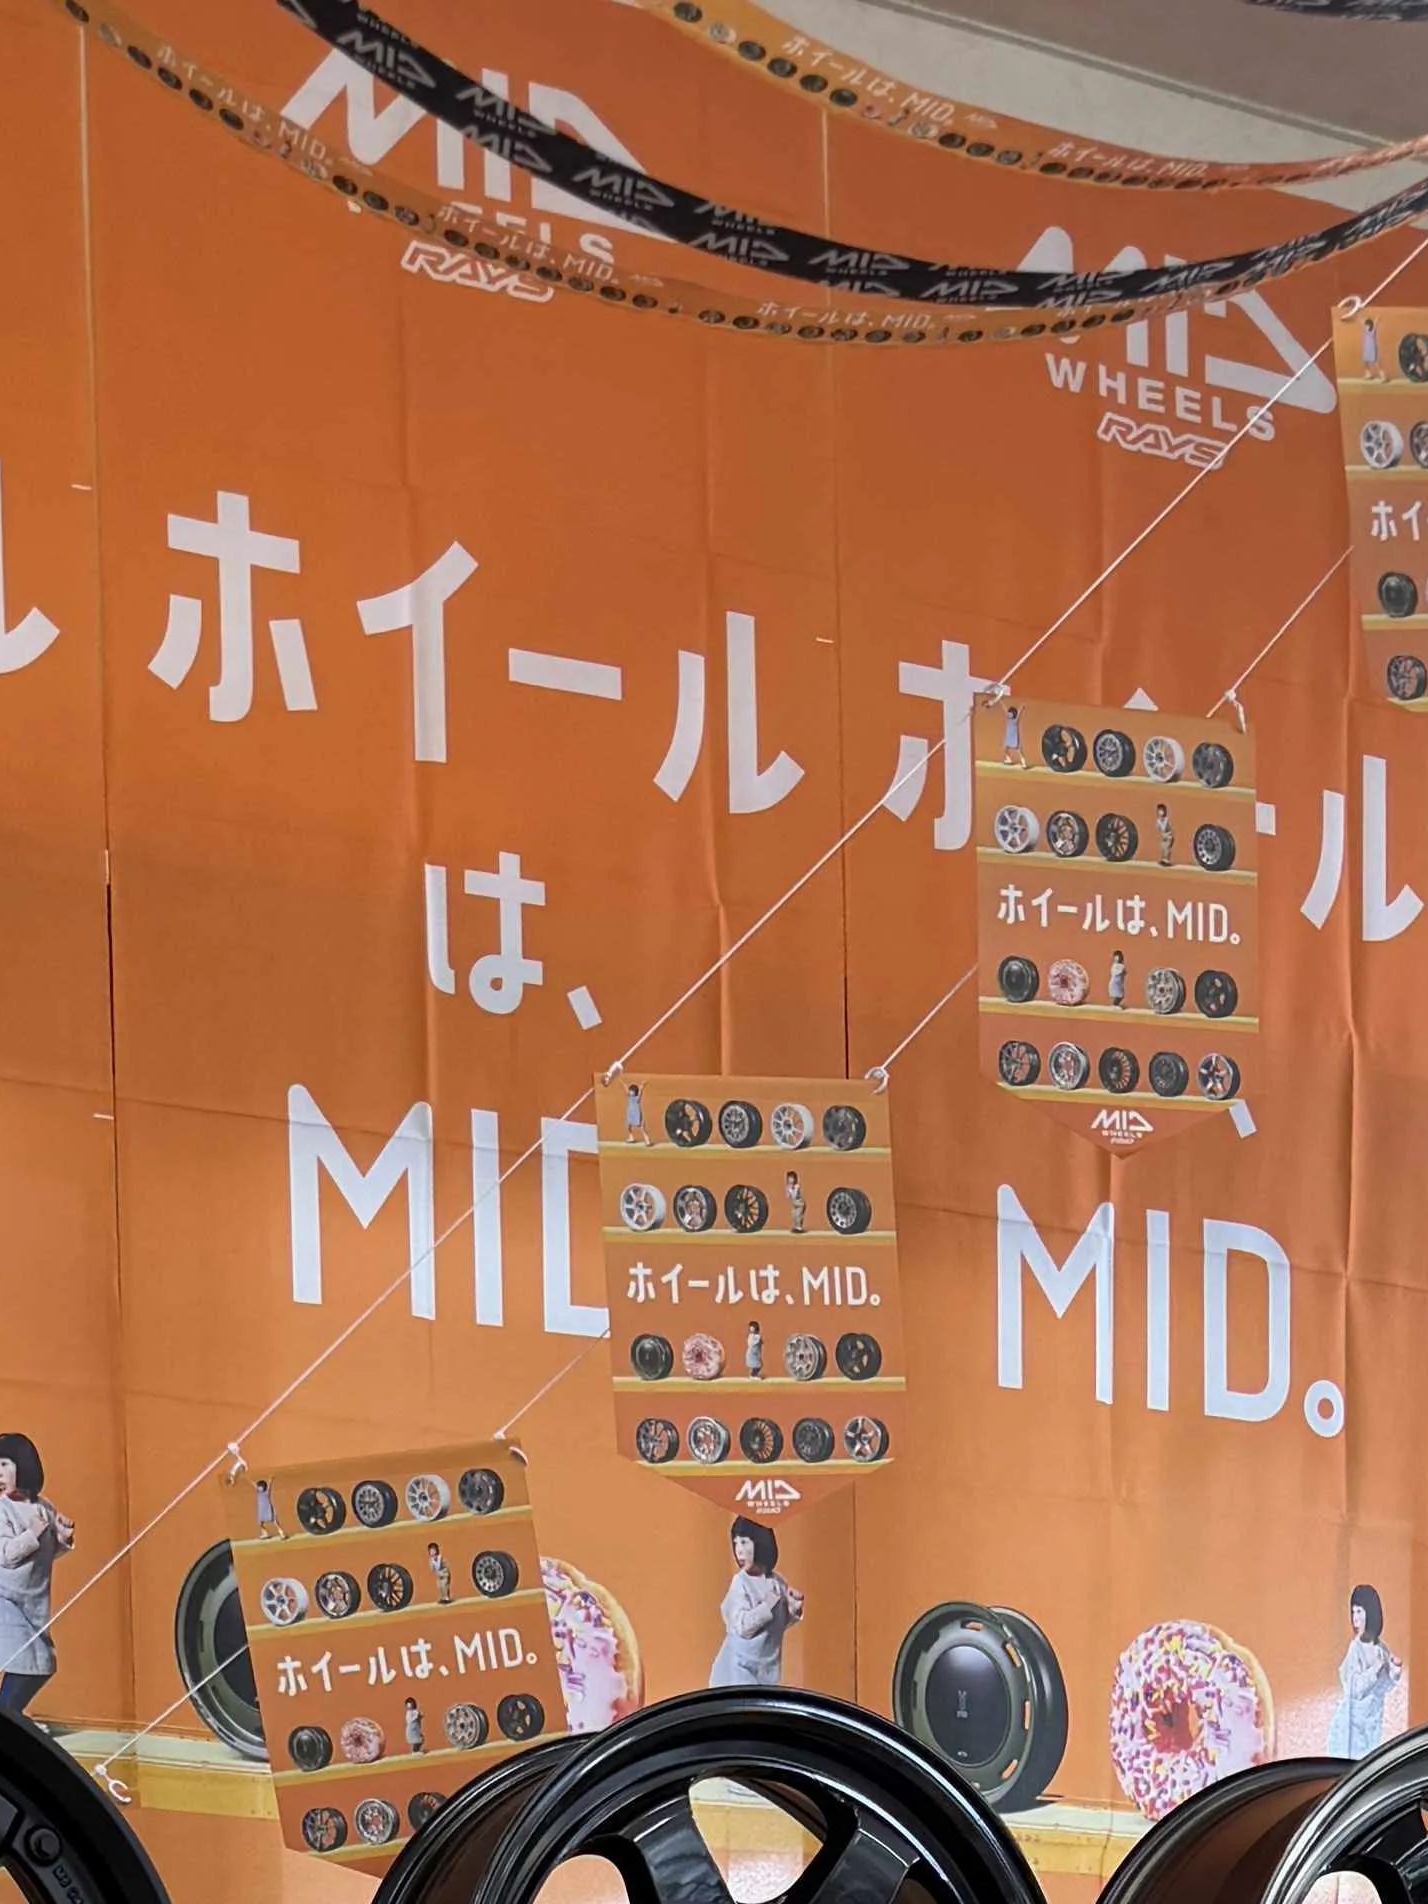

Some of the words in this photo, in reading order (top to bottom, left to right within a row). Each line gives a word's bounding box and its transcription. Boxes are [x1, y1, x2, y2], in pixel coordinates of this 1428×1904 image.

[1045, 352, 1276, 441] WHEELS
[1097, 412, 1229, 471] RAYS
[147, 490, 805, 814] ホイール
[424, 851, 602, 1030] は、
[997, 884, 1243, 946] ホイールは、MID。
[627, 1263, 882, 1307] ホイールは、MID。
[997, 1184, 1345, 1437] MID。
[277, 1628, 538, 1696] ホイールは、MID。
